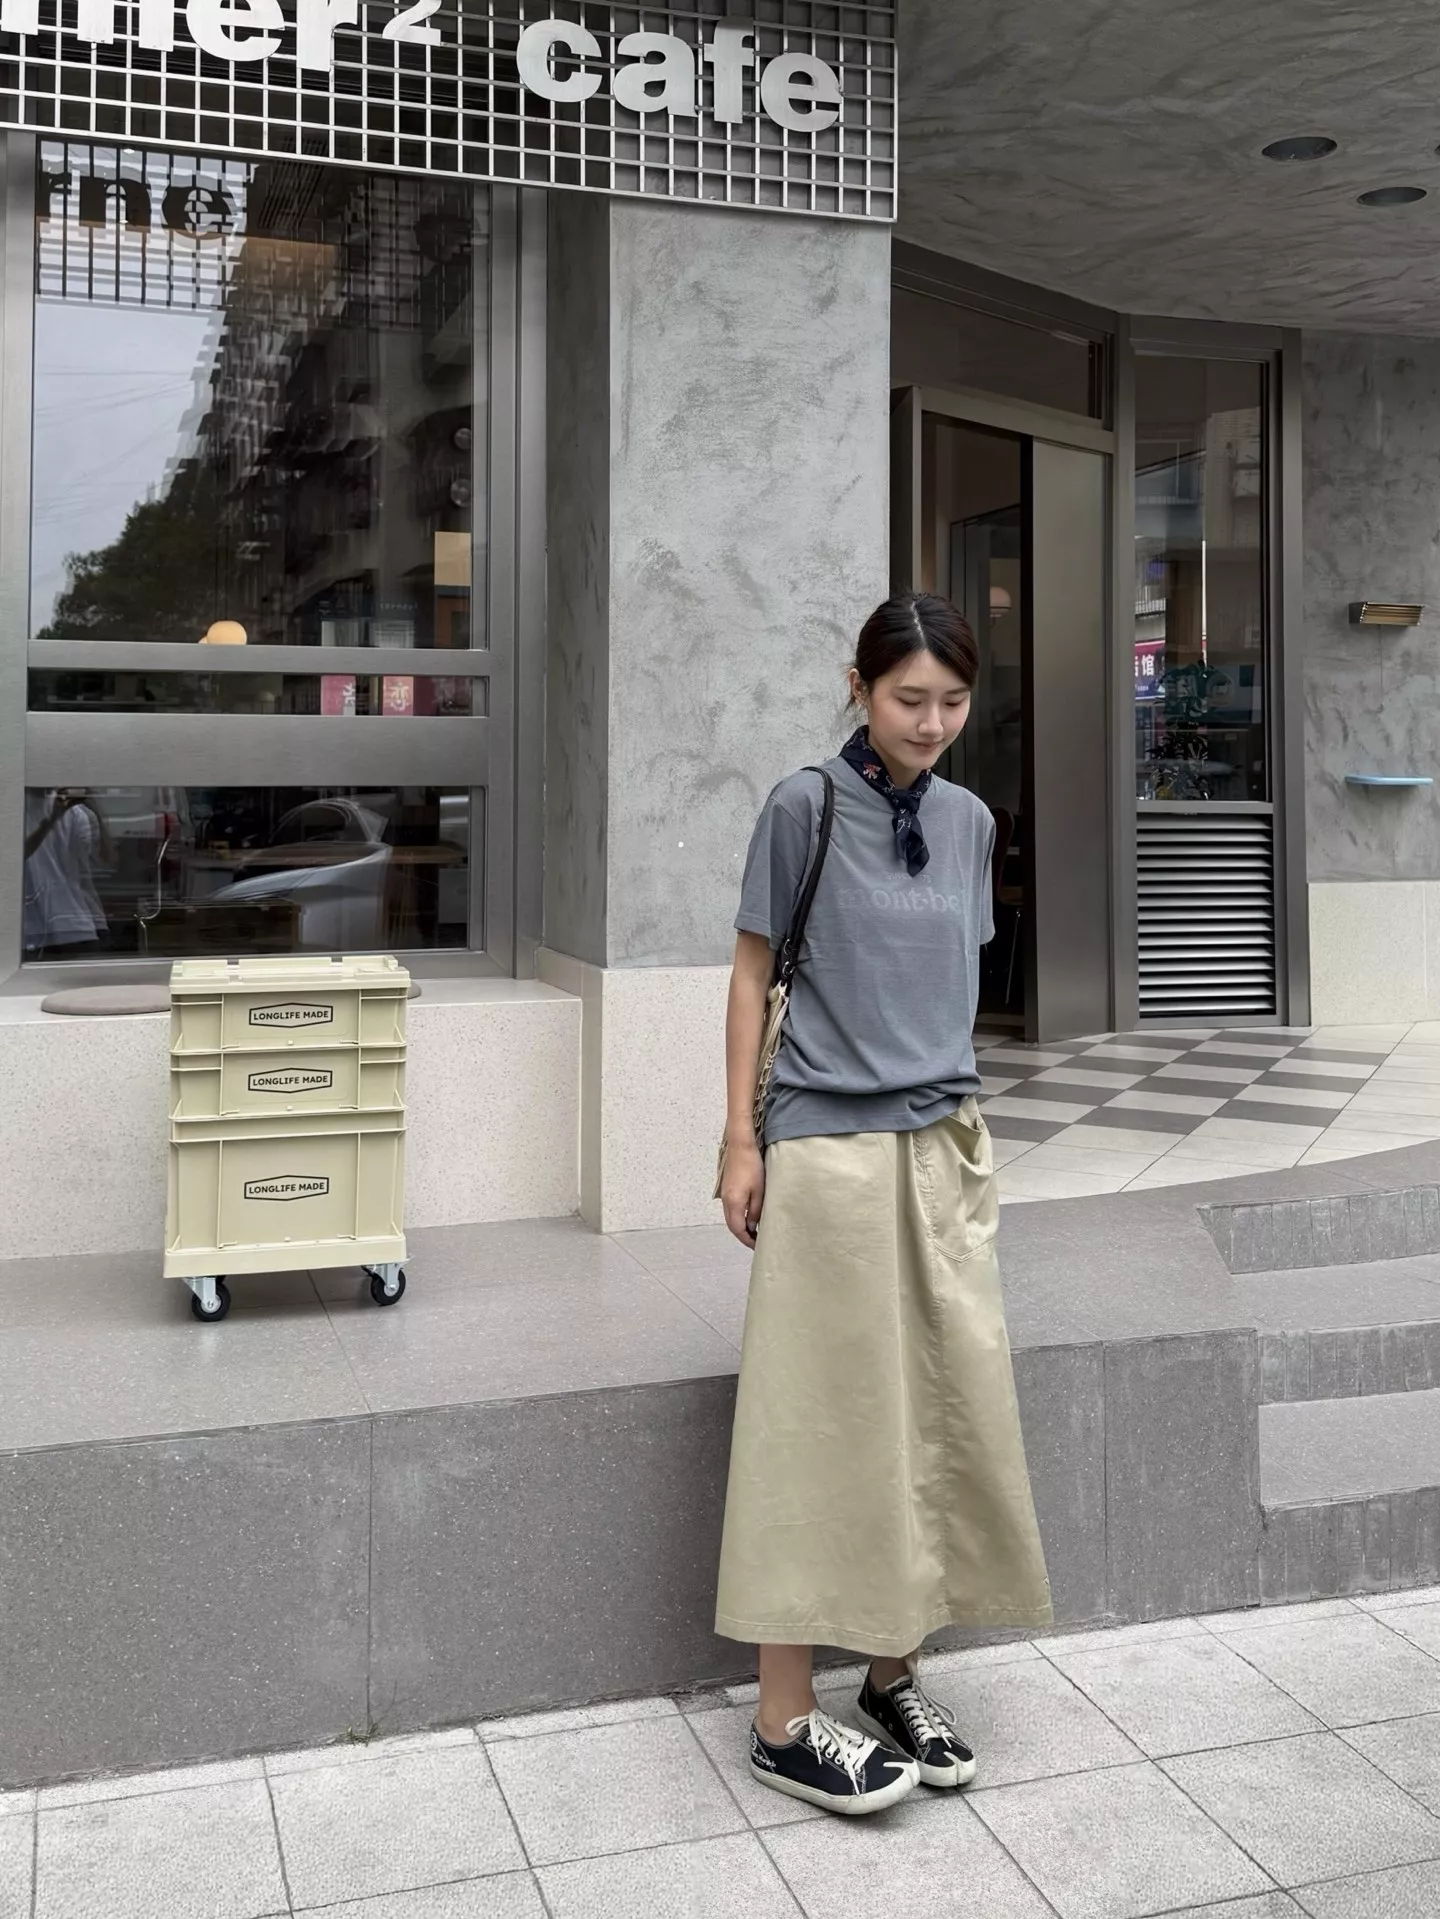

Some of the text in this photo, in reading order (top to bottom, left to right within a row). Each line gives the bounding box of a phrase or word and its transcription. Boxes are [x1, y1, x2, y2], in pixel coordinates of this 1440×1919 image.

[516, 16, 842, 132] cafe
[253, 1010, 329, 1021] LONGLIFE MADE
[252, 1075, 328, 1086] LONGLIFE MADE
[249, 1182, 325, 1194] LONGLIFE MADE
